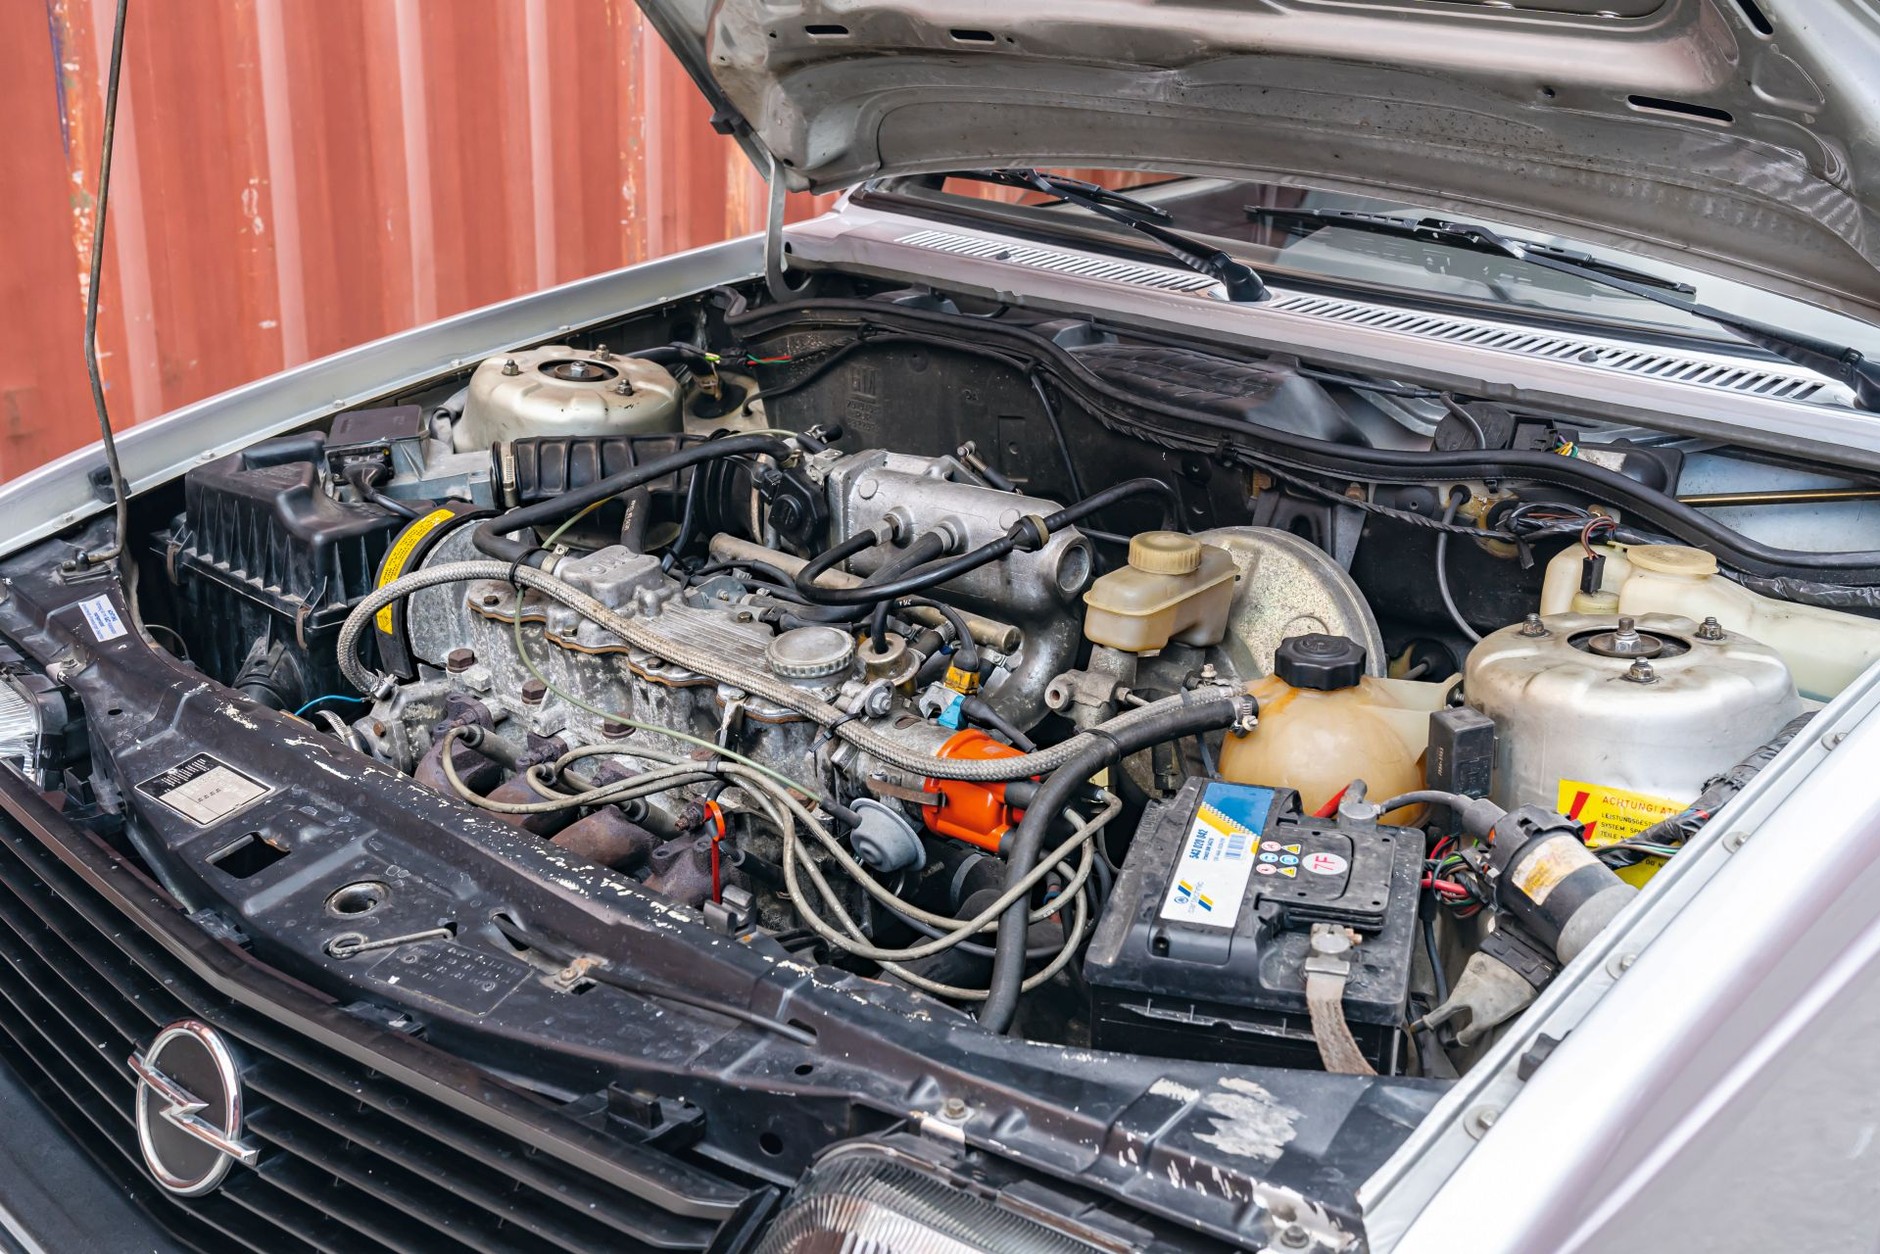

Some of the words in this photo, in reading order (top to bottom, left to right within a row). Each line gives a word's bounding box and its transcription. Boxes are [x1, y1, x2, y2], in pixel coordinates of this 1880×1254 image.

[1602, 796, 1657, 812] ACHTUNG!
[1601, 812, 1654, 826] LEISTUNGSGEST
[1601, 822, 1625, 831] SYSTEM
[1600, 831, 1617, 839] TEILE
[1313, 855, 1335, 871] 7F
